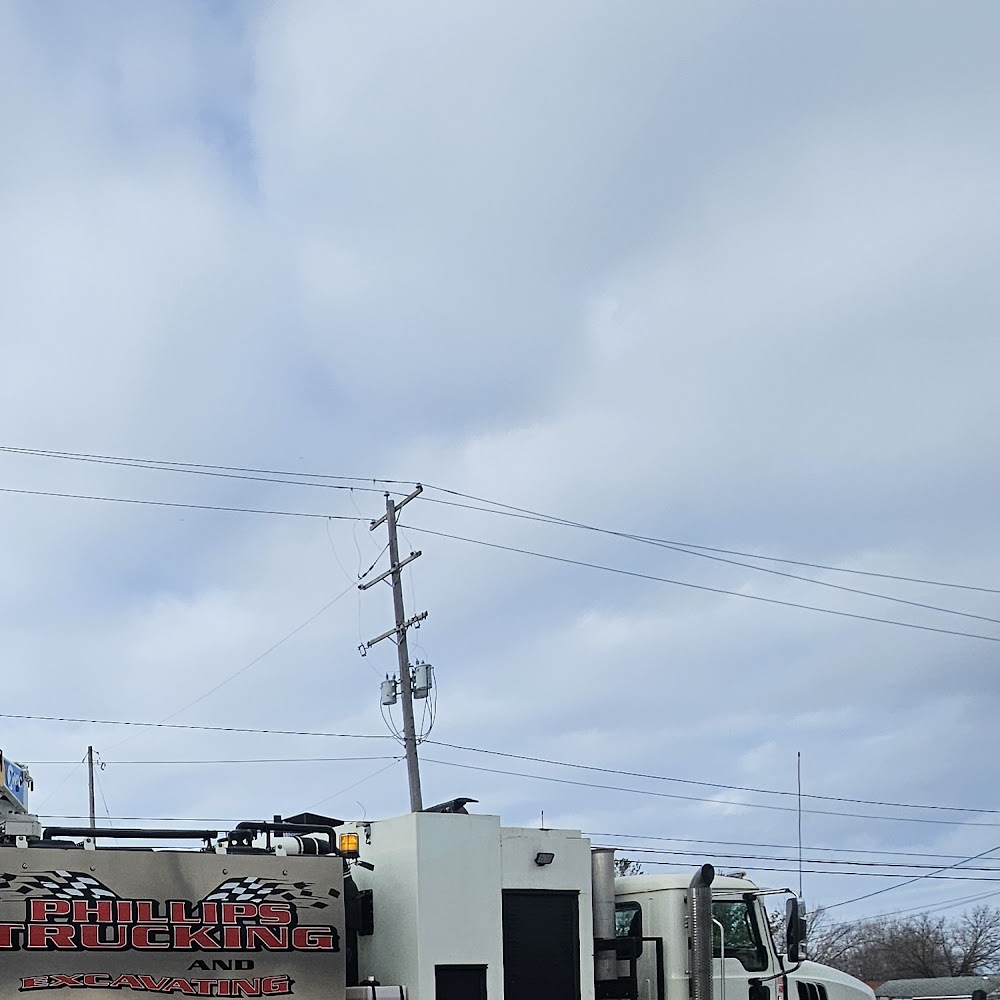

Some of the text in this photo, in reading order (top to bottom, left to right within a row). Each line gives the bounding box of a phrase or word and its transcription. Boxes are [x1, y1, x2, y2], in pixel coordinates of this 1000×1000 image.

[27, 898, 295, 926] PHILLIPS
[187, 959, 255, 971] AND
[20, 973, 294, 997] EXCAVATING
